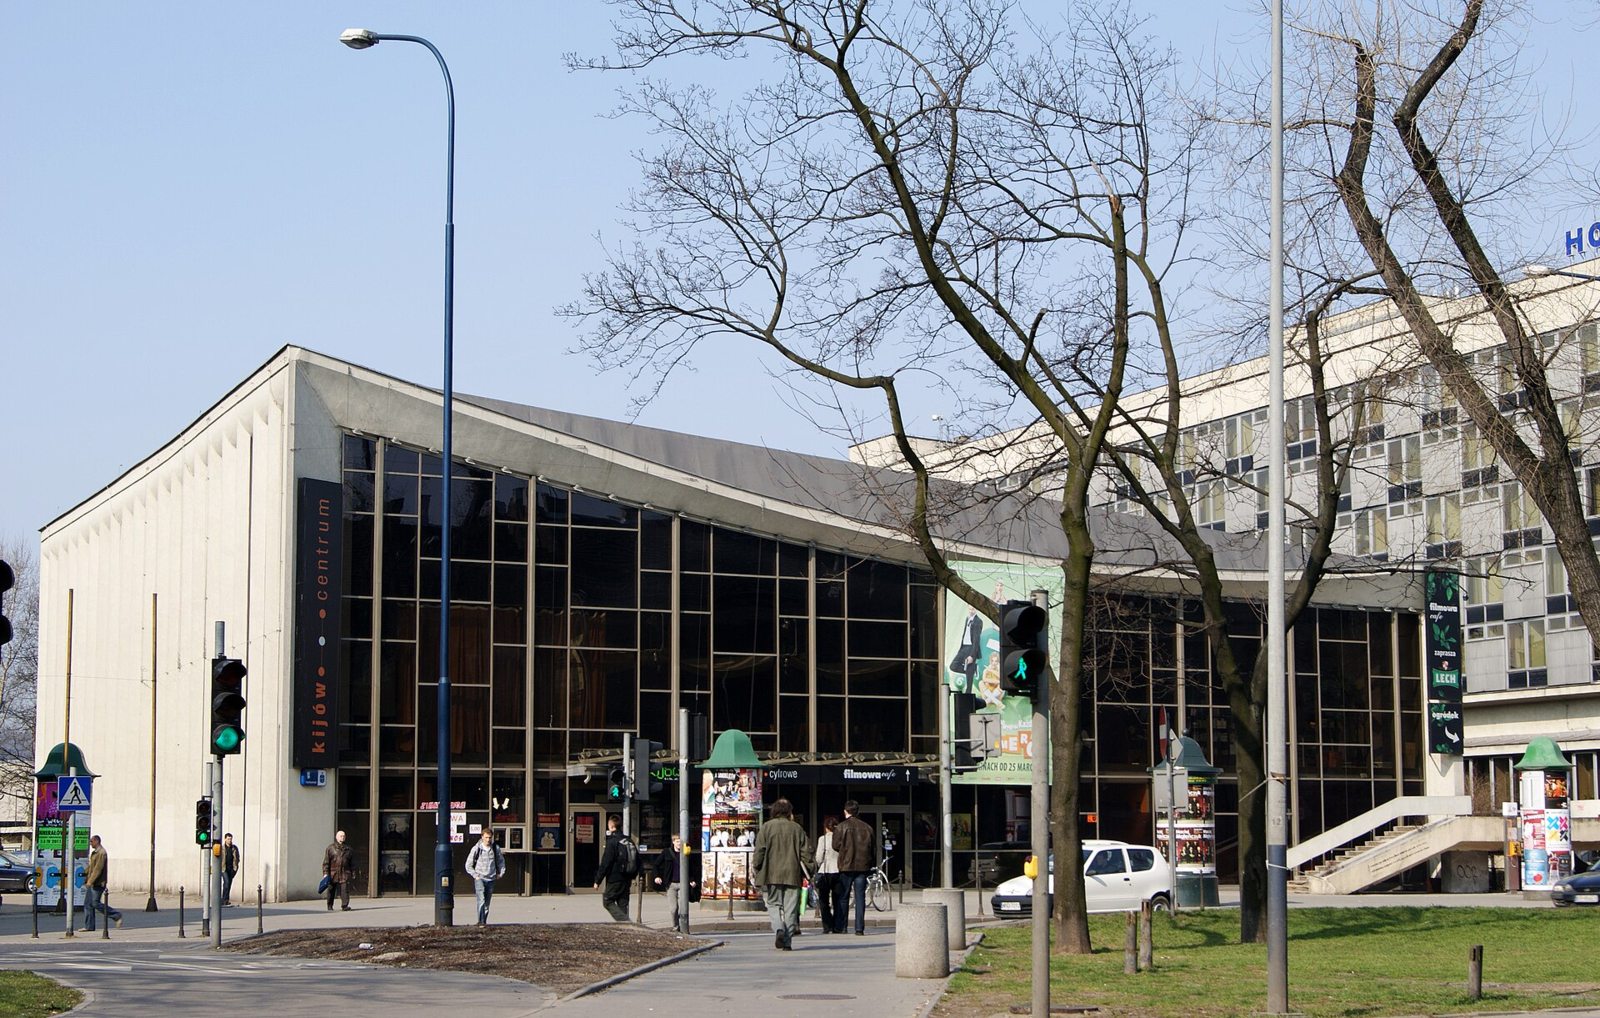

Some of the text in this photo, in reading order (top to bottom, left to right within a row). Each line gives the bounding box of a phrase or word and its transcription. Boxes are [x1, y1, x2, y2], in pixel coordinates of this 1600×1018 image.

[1429, 602, 1458, 612] filmowa
[1430, 612, 1443, 622] cafe
[312, 498, 331, 753] kijów centrum
[1434, 650, 1456, 659] zaprasza
[1435, 673, 1456, 684] LECH
[1432, 710, 1459, 720] ogródek
[1000, 763, 1008, 772] OD
[1009, 763, 1016, 772] 25
[769, 769, 798, 780] cyfrowe
[843, 769, 896, 780] filmowa cafe
